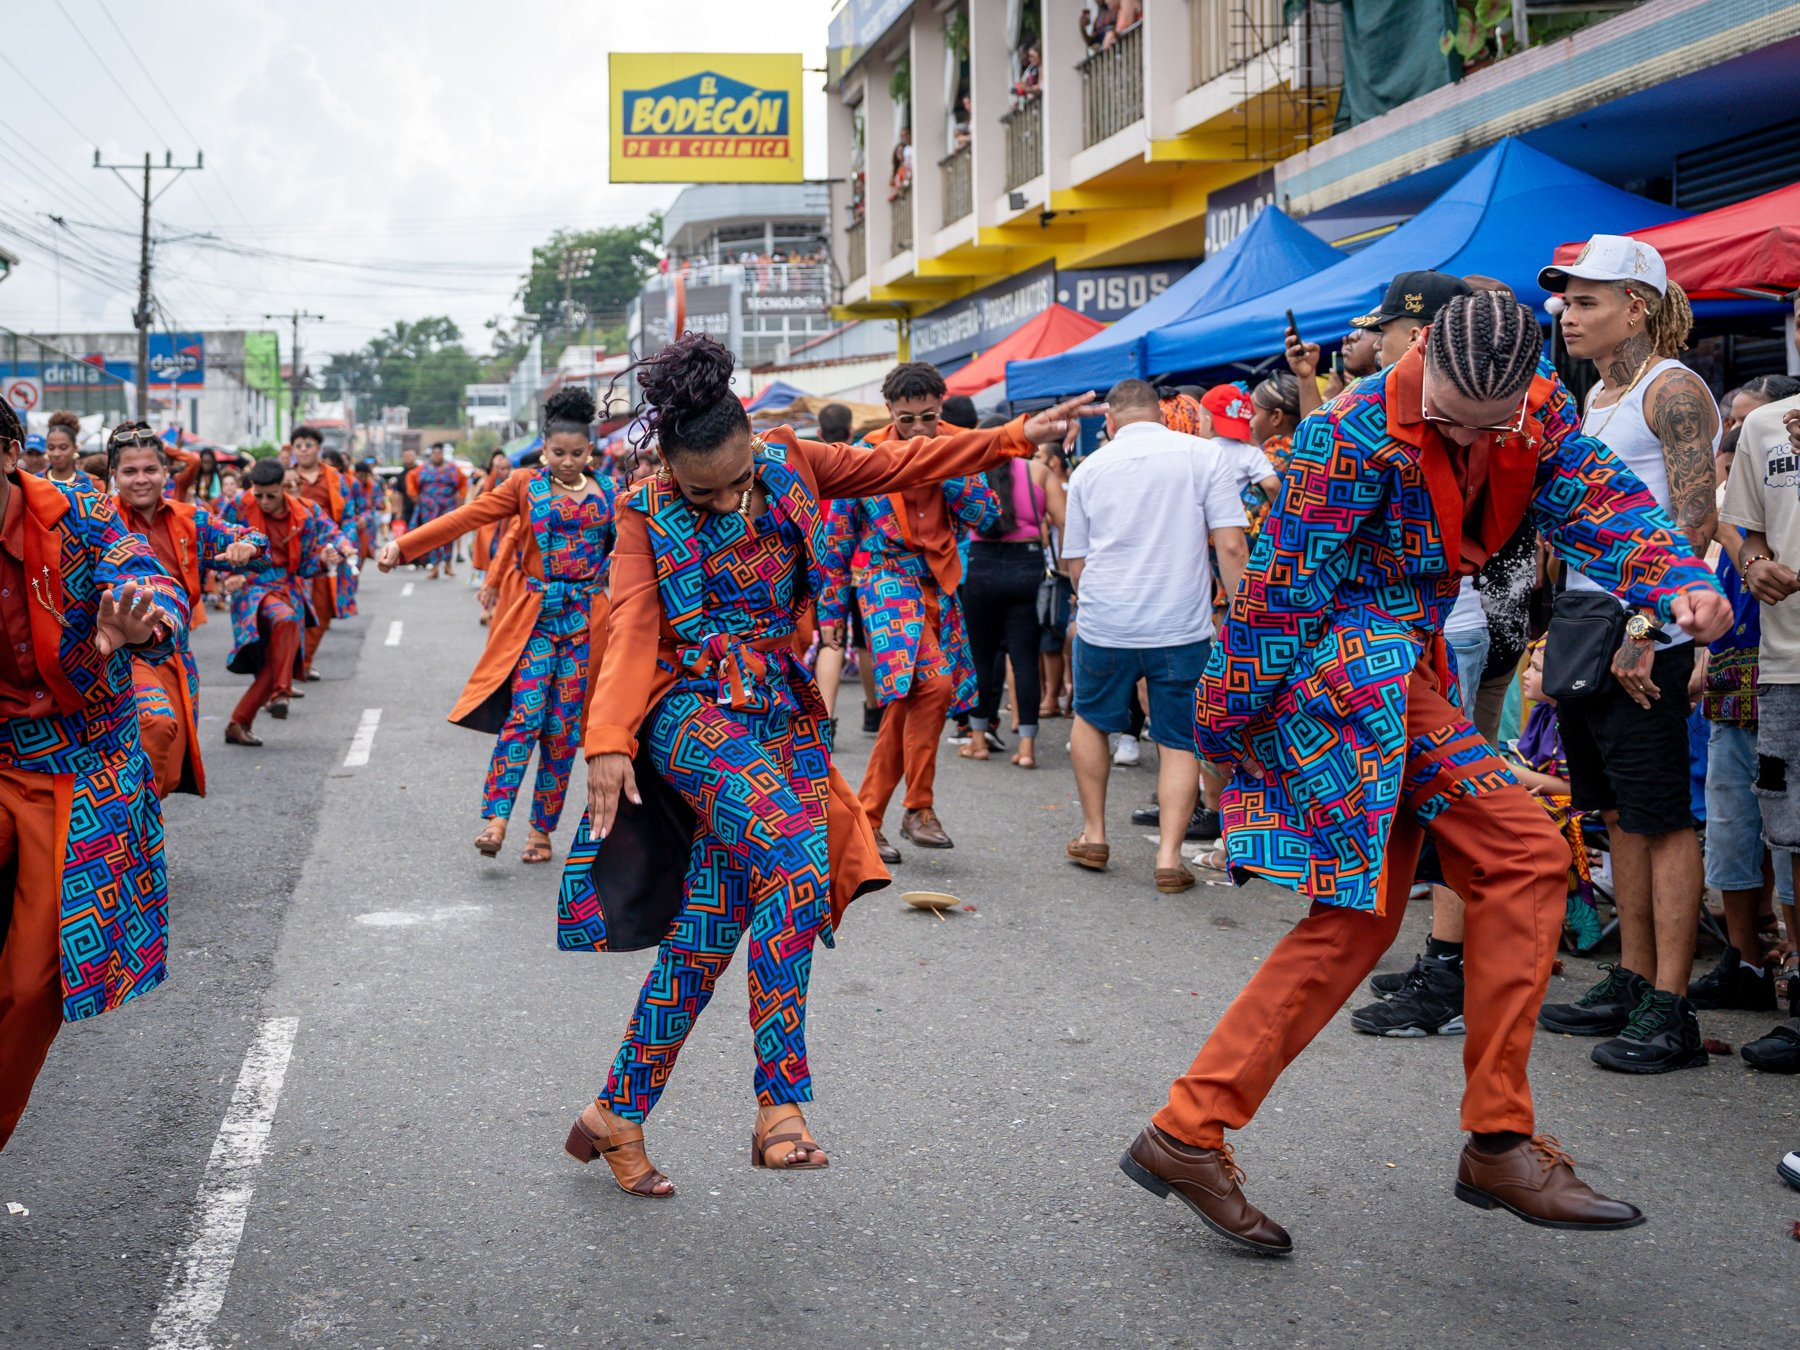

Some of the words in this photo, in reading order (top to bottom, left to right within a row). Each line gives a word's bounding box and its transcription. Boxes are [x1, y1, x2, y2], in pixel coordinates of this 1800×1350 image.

[699, 77, 718, 95] EL
[630, 90, 782, 134] BODEGÓN
[626, 141, 650, 156] DE
[658, 141, 681, 156] LA
[689, 138, 785, 156] CERÁMICA
[1211, 202, 1248, 253] LOZA
[1076, 273, 1169, 312] PISOS
[151, 353, 197, 370] delta
[44, 362, 100, 383] delta
